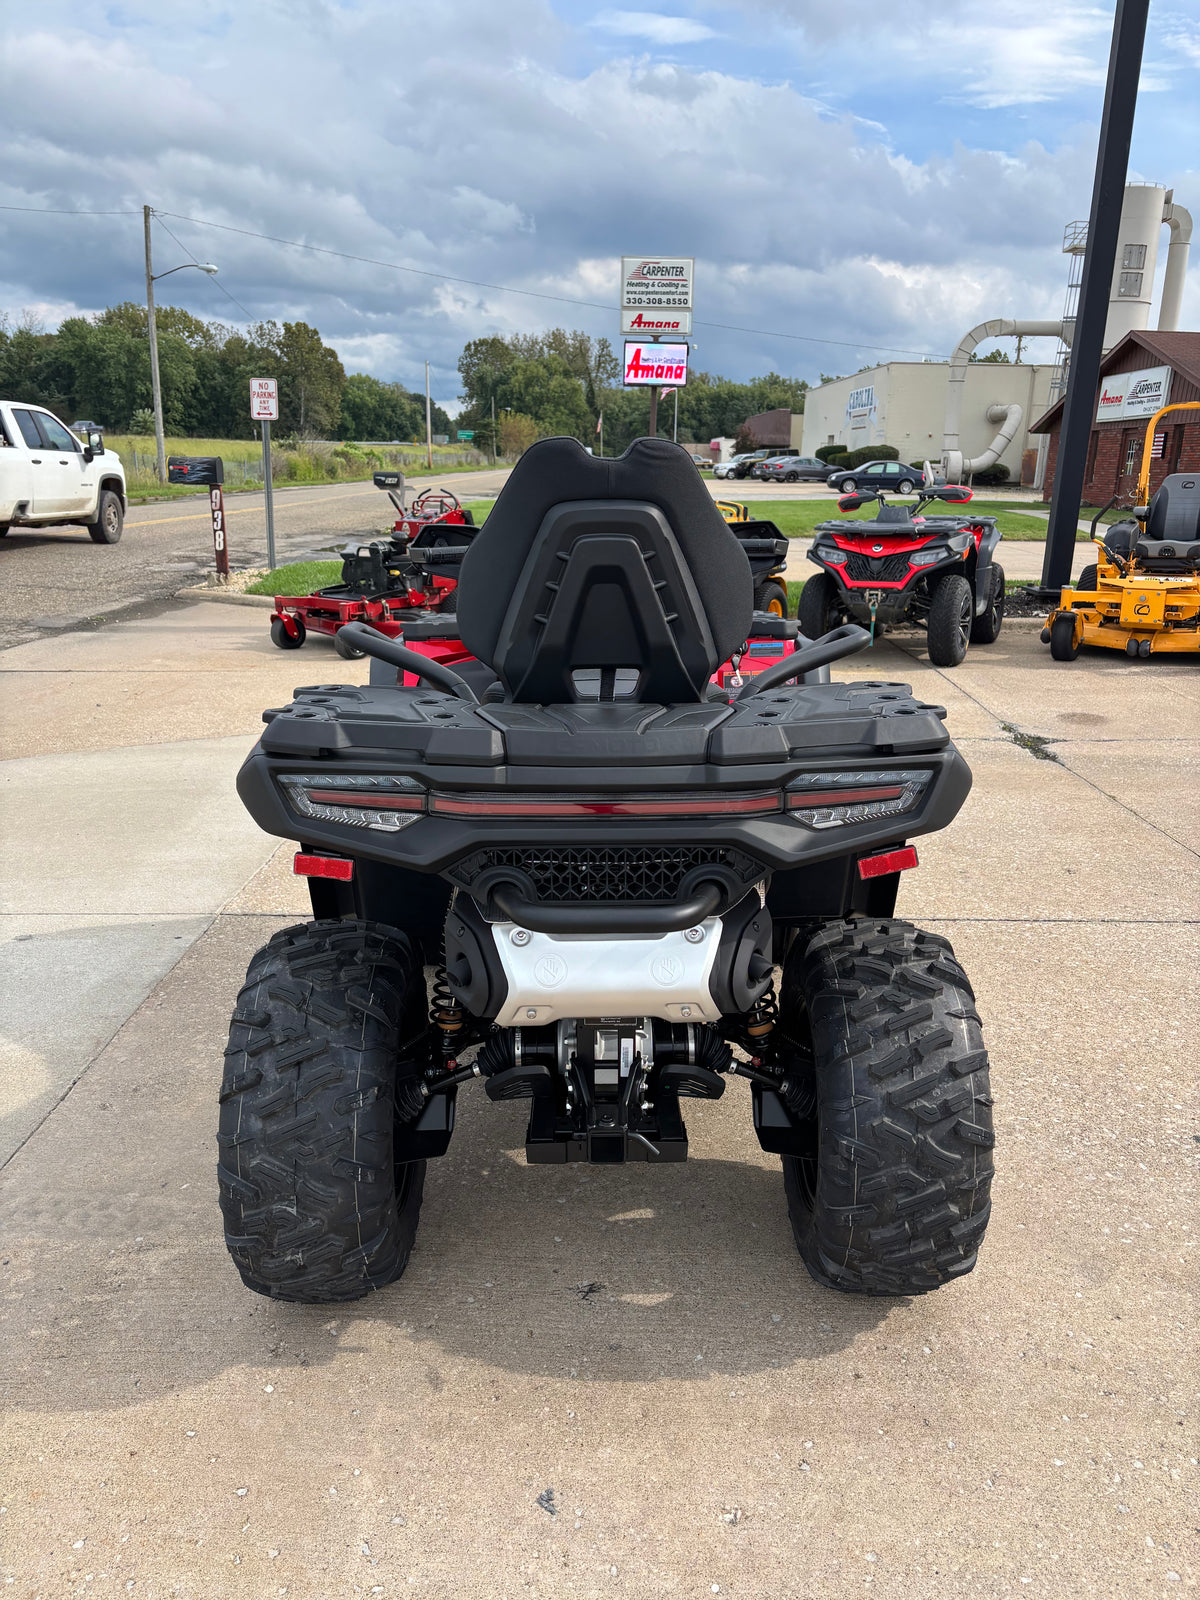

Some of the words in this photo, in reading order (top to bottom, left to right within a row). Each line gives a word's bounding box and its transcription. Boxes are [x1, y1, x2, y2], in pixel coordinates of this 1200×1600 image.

[641, 265, 684, 277] CARPENTER
[626, 281, 649, 289] Heating
[630, 313, 680, 329] Amana
[626, 348, 685, 379] Amana
[258, 382, 269, 390] NO
[253, 391, 276, 399] PARKING
[1100, 389, 1123, 405] Amana
[211, 489, 224, 551] 938
